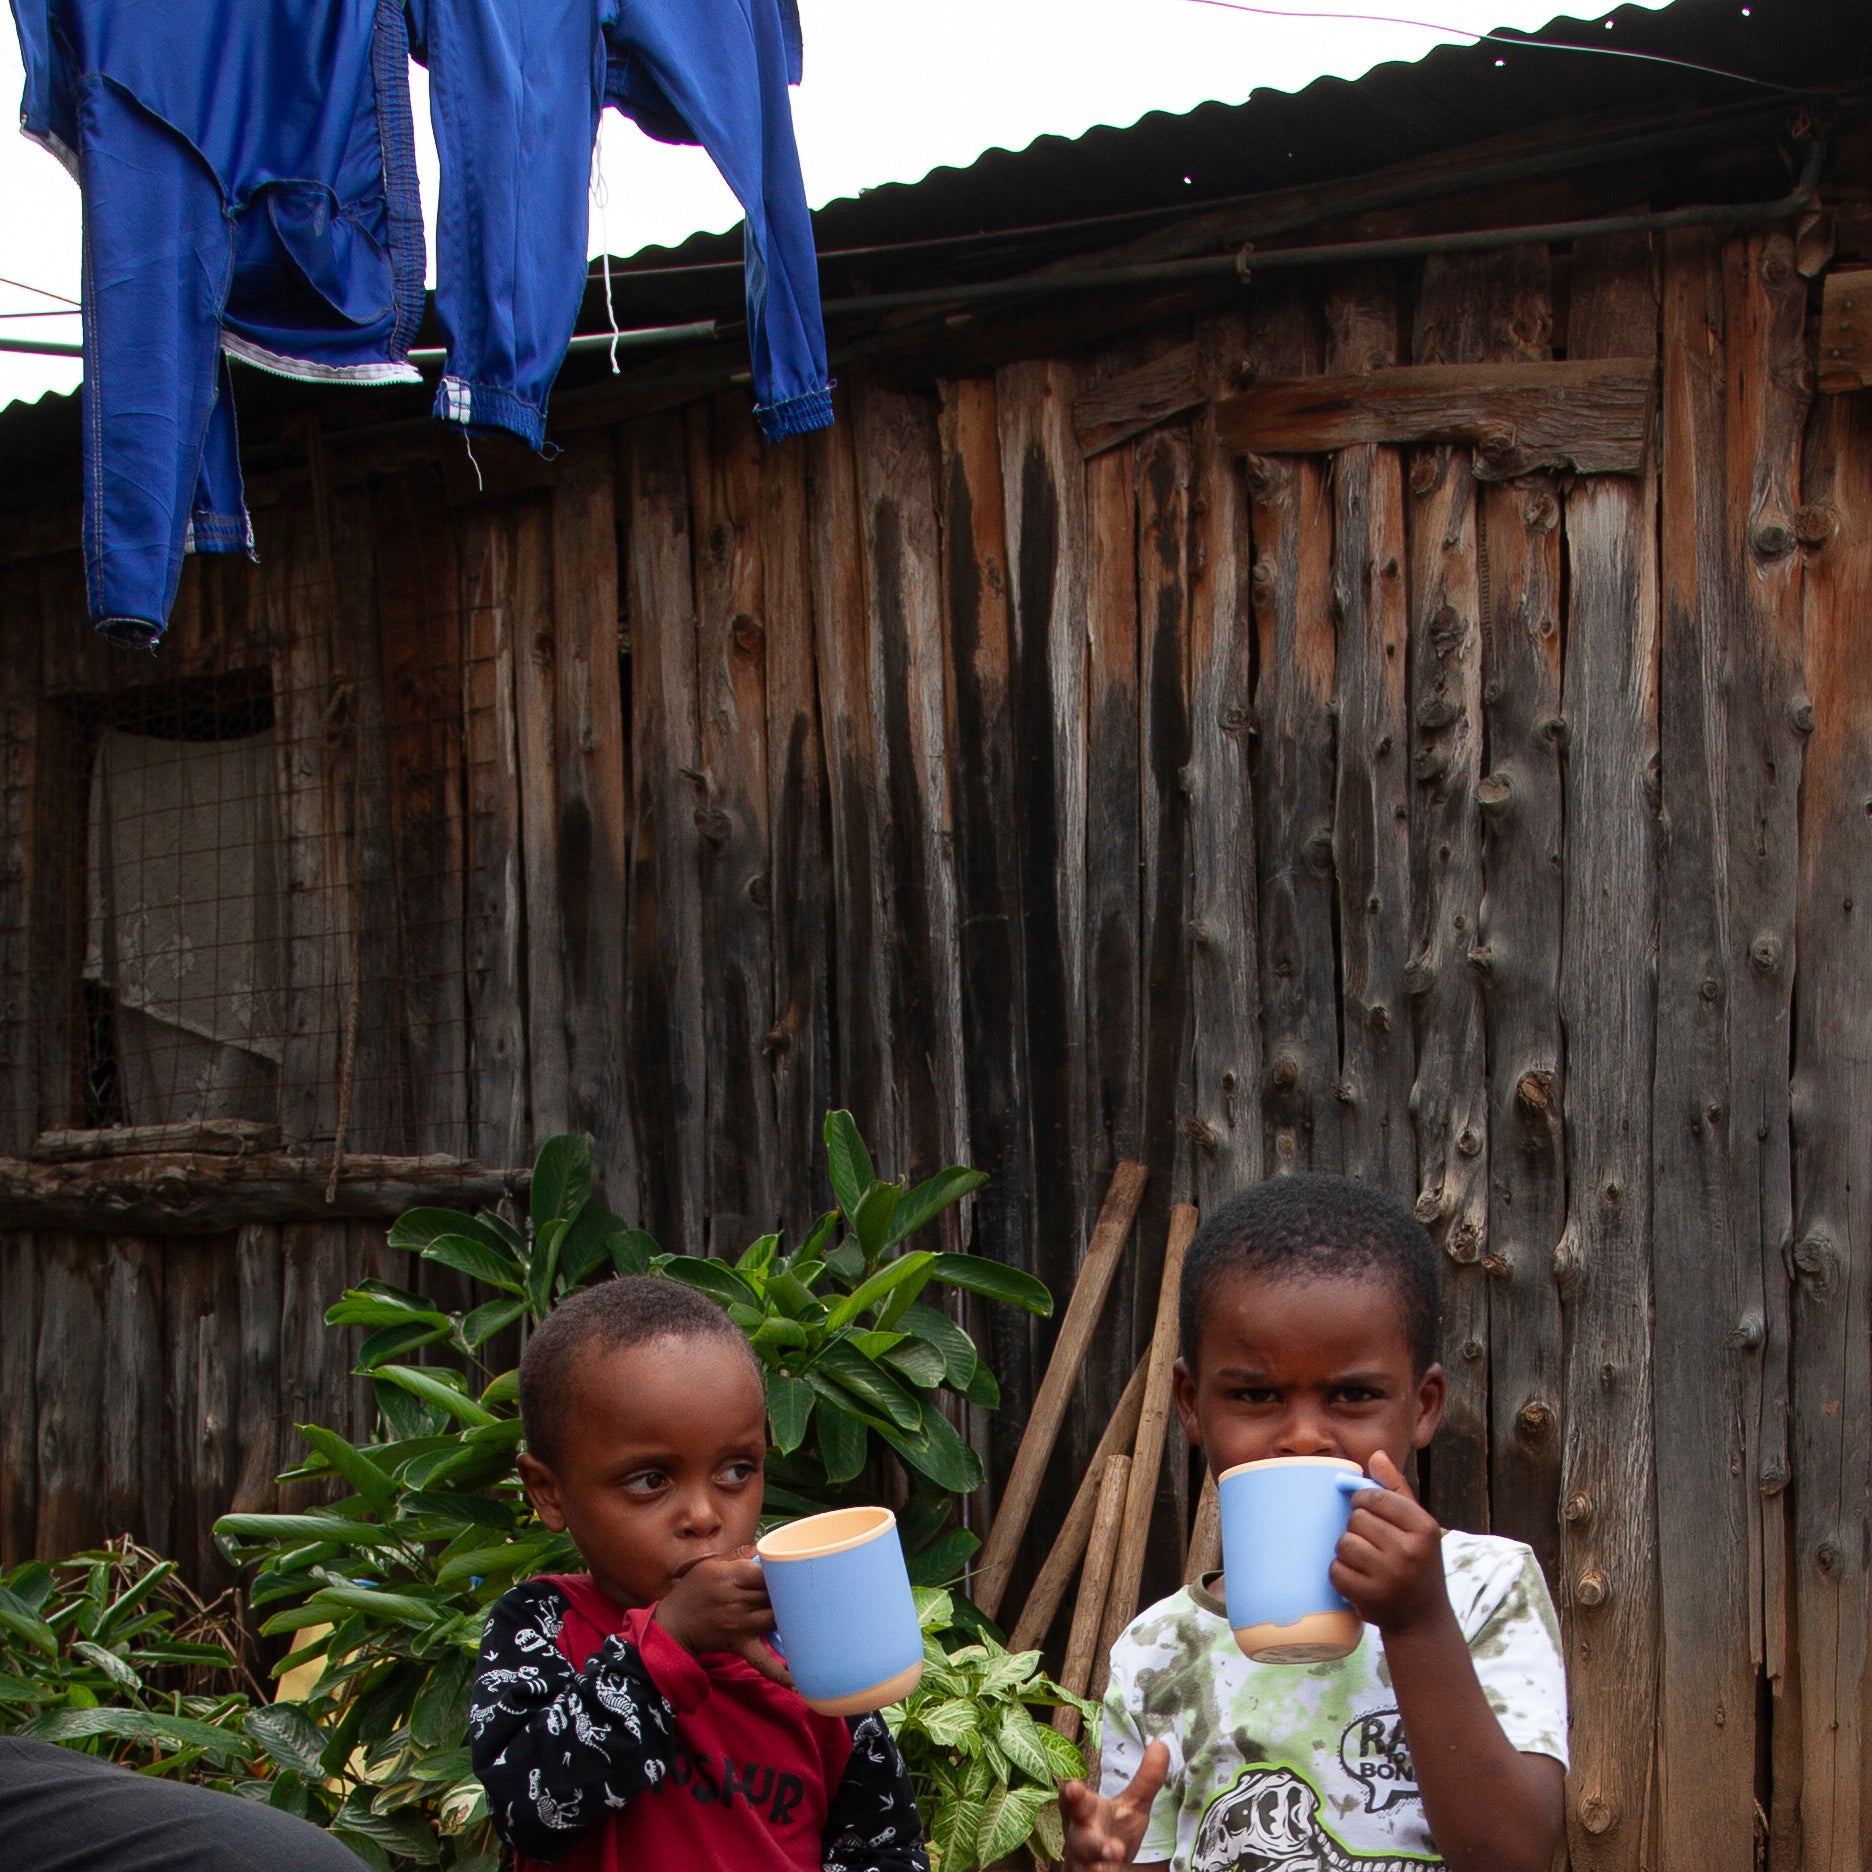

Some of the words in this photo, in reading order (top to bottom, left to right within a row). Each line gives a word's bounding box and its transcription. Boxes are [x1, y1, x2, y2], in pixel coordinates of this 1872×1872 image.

[1359, 1718, 1411, 1757] RA
[651, 1751, 804, 1824] OSAUR
[1359, 1762, 1415, 1782] BON
